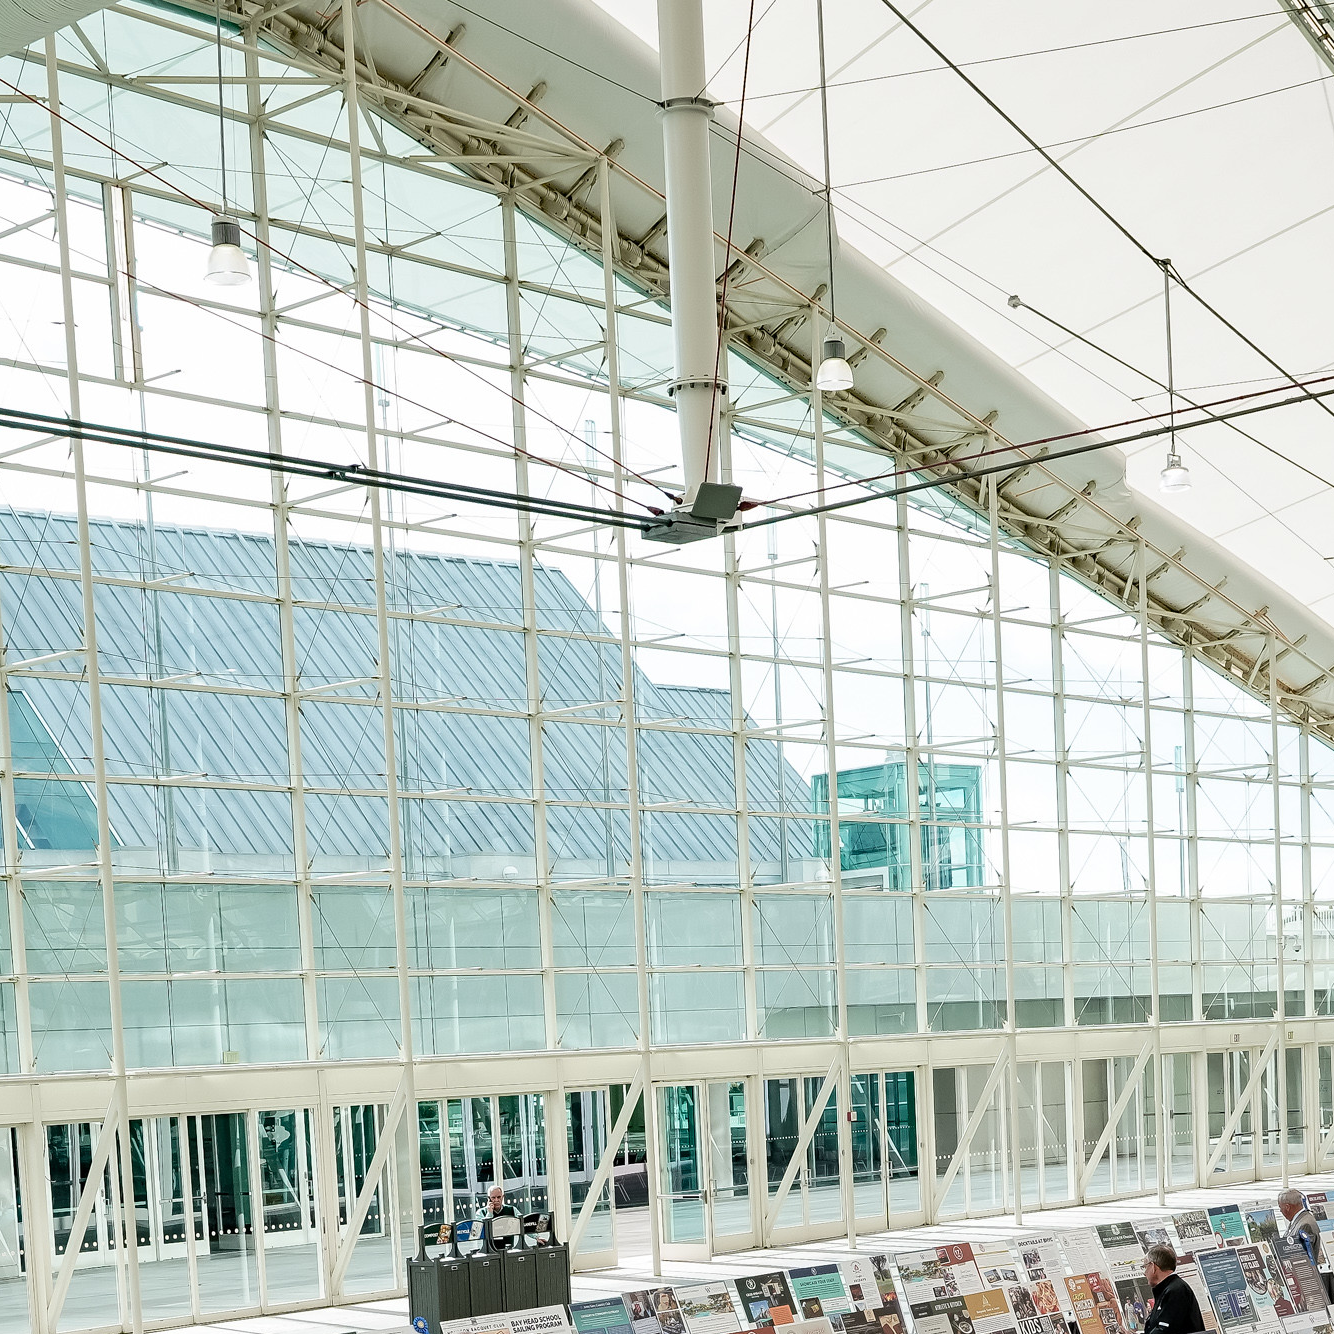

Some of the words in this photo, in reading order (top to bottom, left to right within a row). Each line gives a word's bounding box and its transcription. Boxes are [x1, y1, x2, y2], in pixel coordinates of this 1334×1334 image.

[539, 1315, 561, 1324] SCHOOL
[513, 1325, 536, 1334] SAILING
[536, 1321, 562, 1329] PROGRAM
